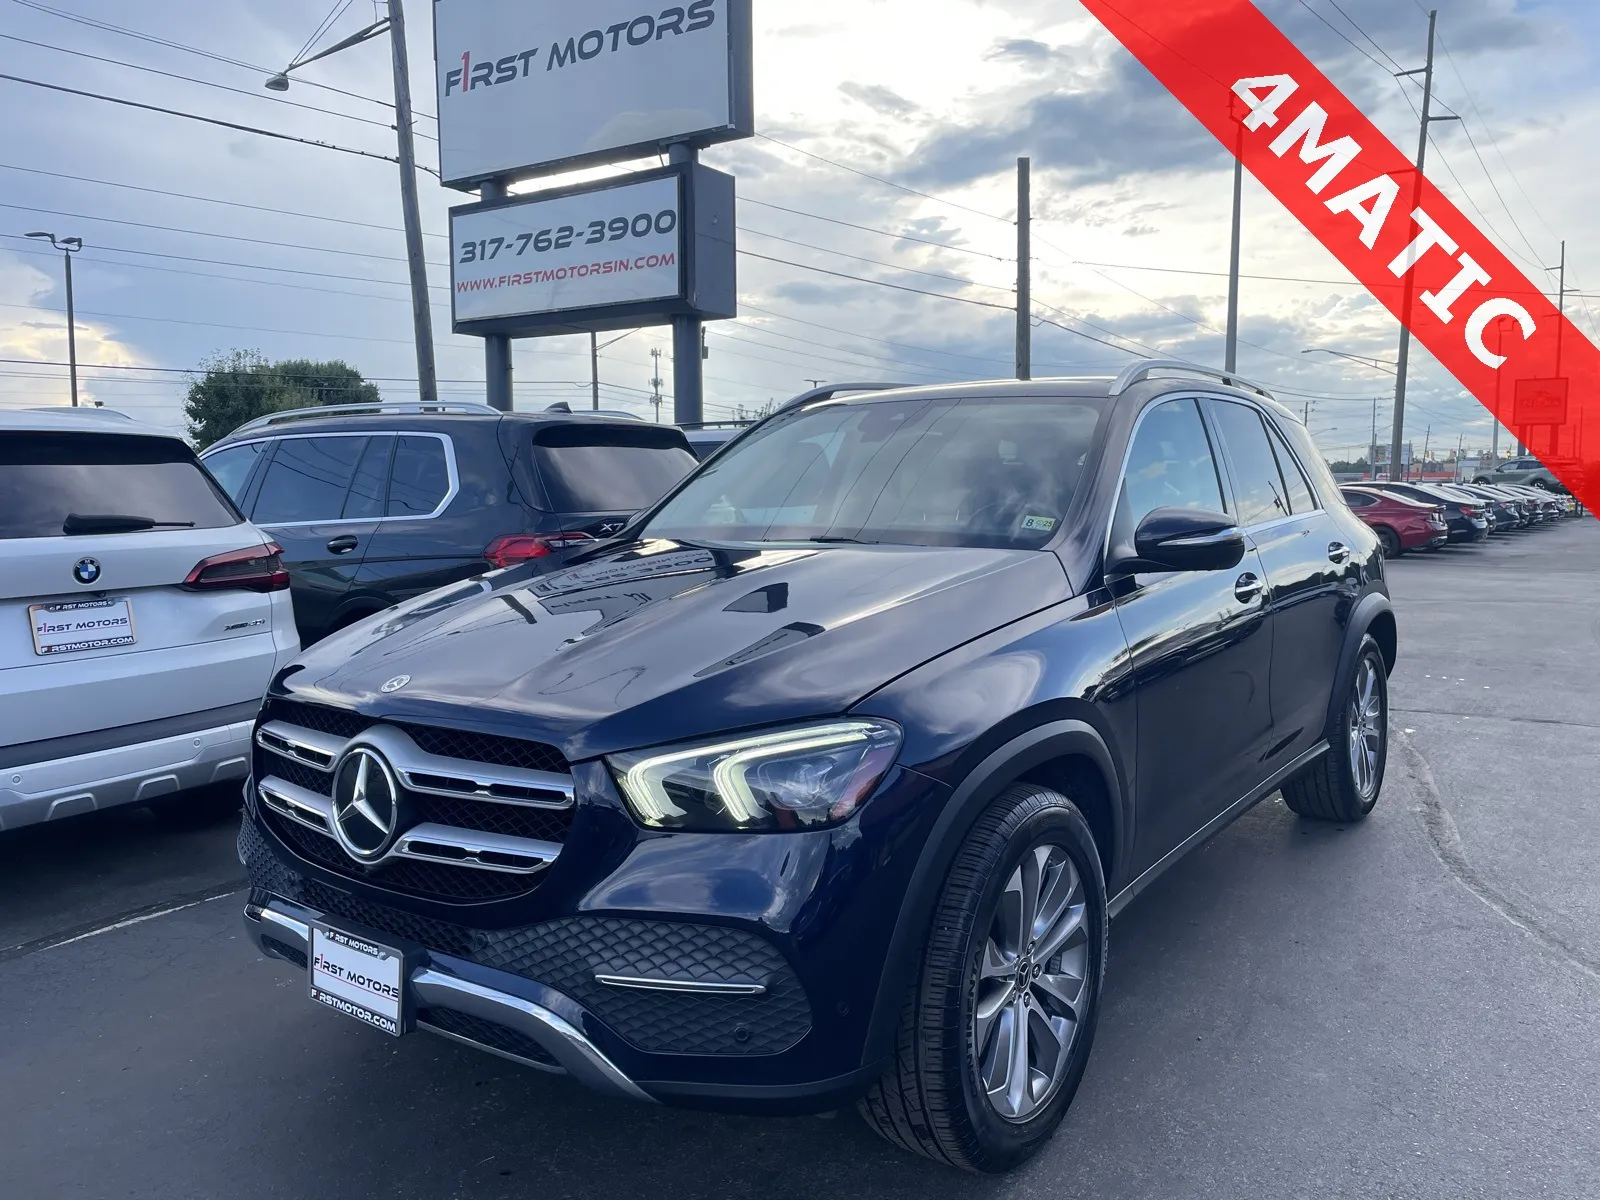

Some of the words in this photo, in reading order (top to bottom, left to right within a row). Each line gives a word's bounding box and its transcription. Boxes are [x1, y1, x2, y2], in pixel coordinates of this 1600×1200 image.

[546, 0, 715, 71] MOTORS
[459, 209, 677, 264] 317-762-3900
[599, 522, 624, 532] X7
[78, 600, 107, 608] MOTORS
[76, 617, 128, 630] MOTORS
[348, 939, 379, 956] MOTORS
[346, 970, 399, 999] MOTORS
